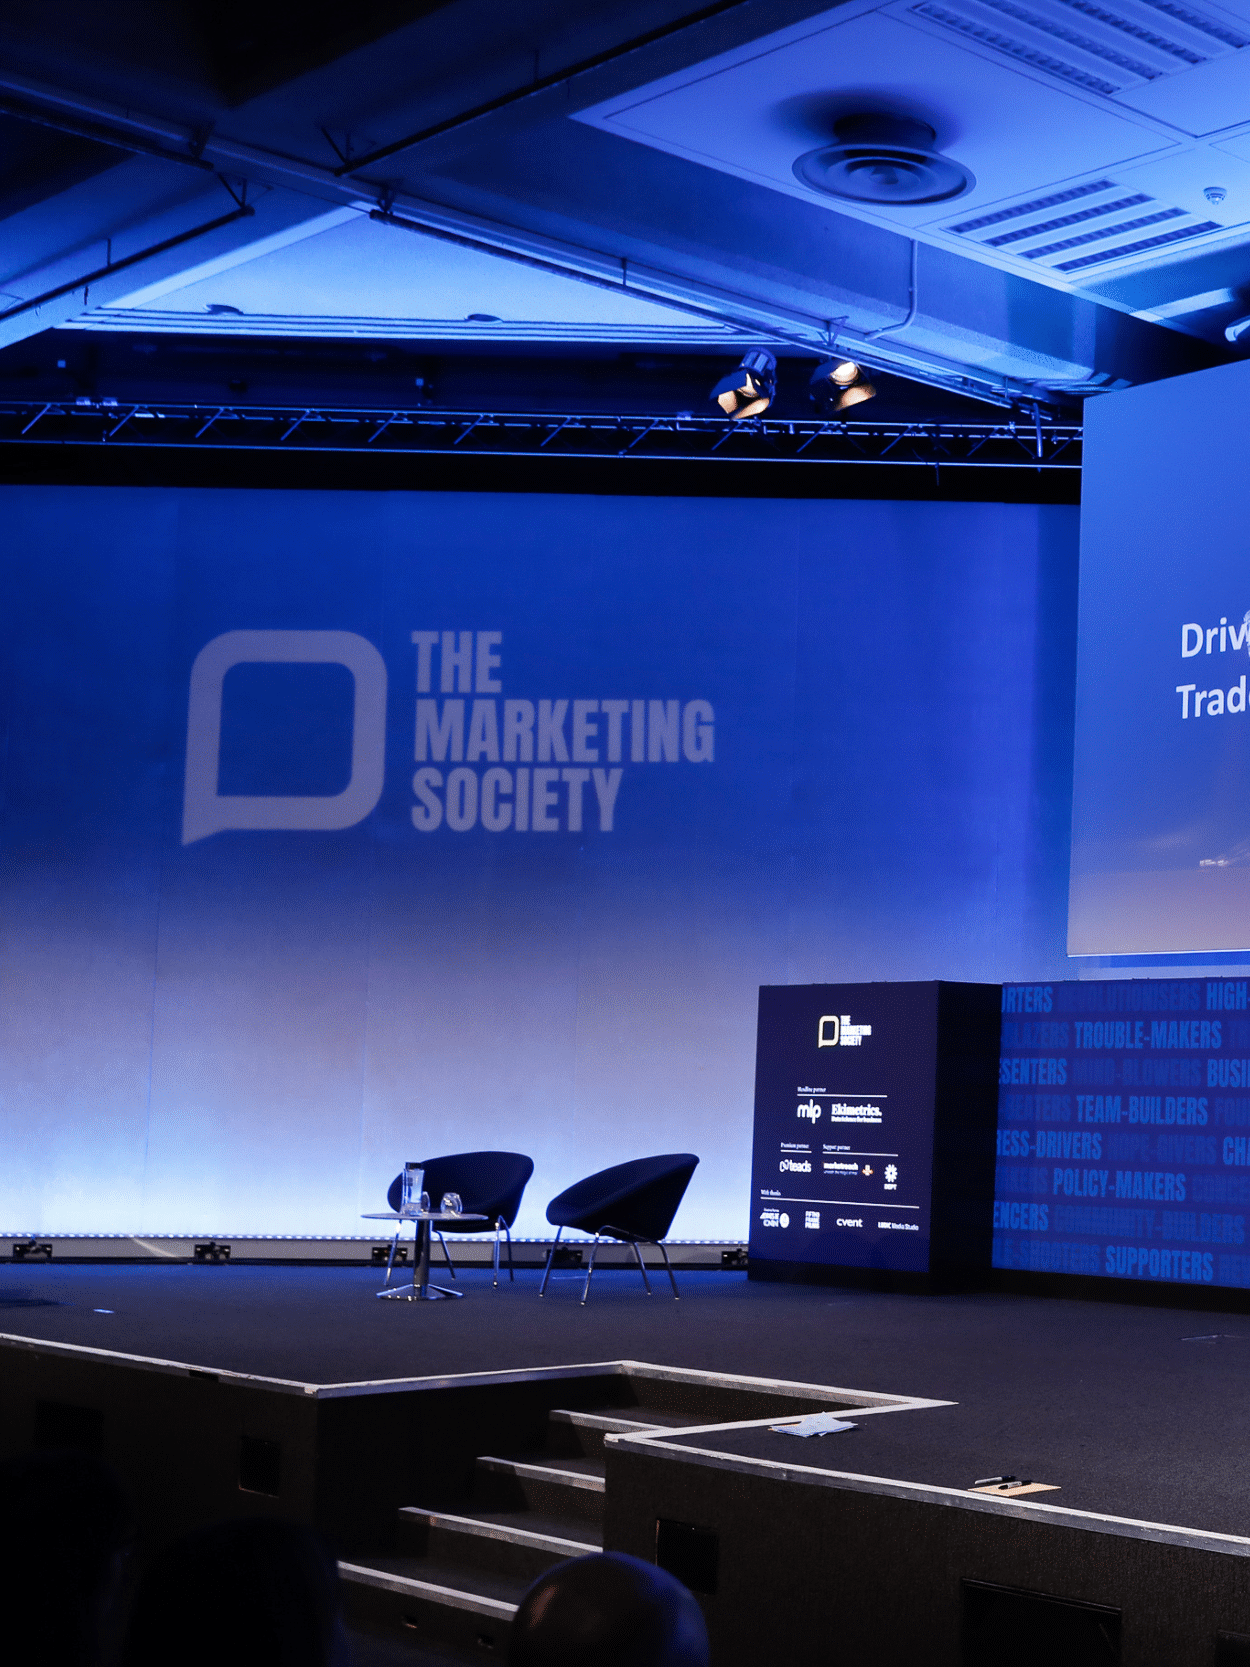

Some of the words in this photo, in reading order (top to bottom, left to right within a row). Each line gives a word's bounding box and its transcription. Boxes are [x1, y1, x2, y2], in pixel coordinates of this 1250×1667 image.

[411, 630, 503, 693] THE
[413, 698, 716, 763] MARKETING
[411, 766, 624, 832] SOCIETY
[1074, 1020, 1222, 1049] TROUBLE-MAKERS
[999, 1057, 1067, 1085] SENTERS
[1076, 1095, 1208, 1126] TEAM-BUILDERS
[1053, 1168, 1187, 1202] POLICY-MAKERS
[836, 1218, 863, 1228] cvent
[1105, 1245, 1213, 1281] SUPPORTERS
